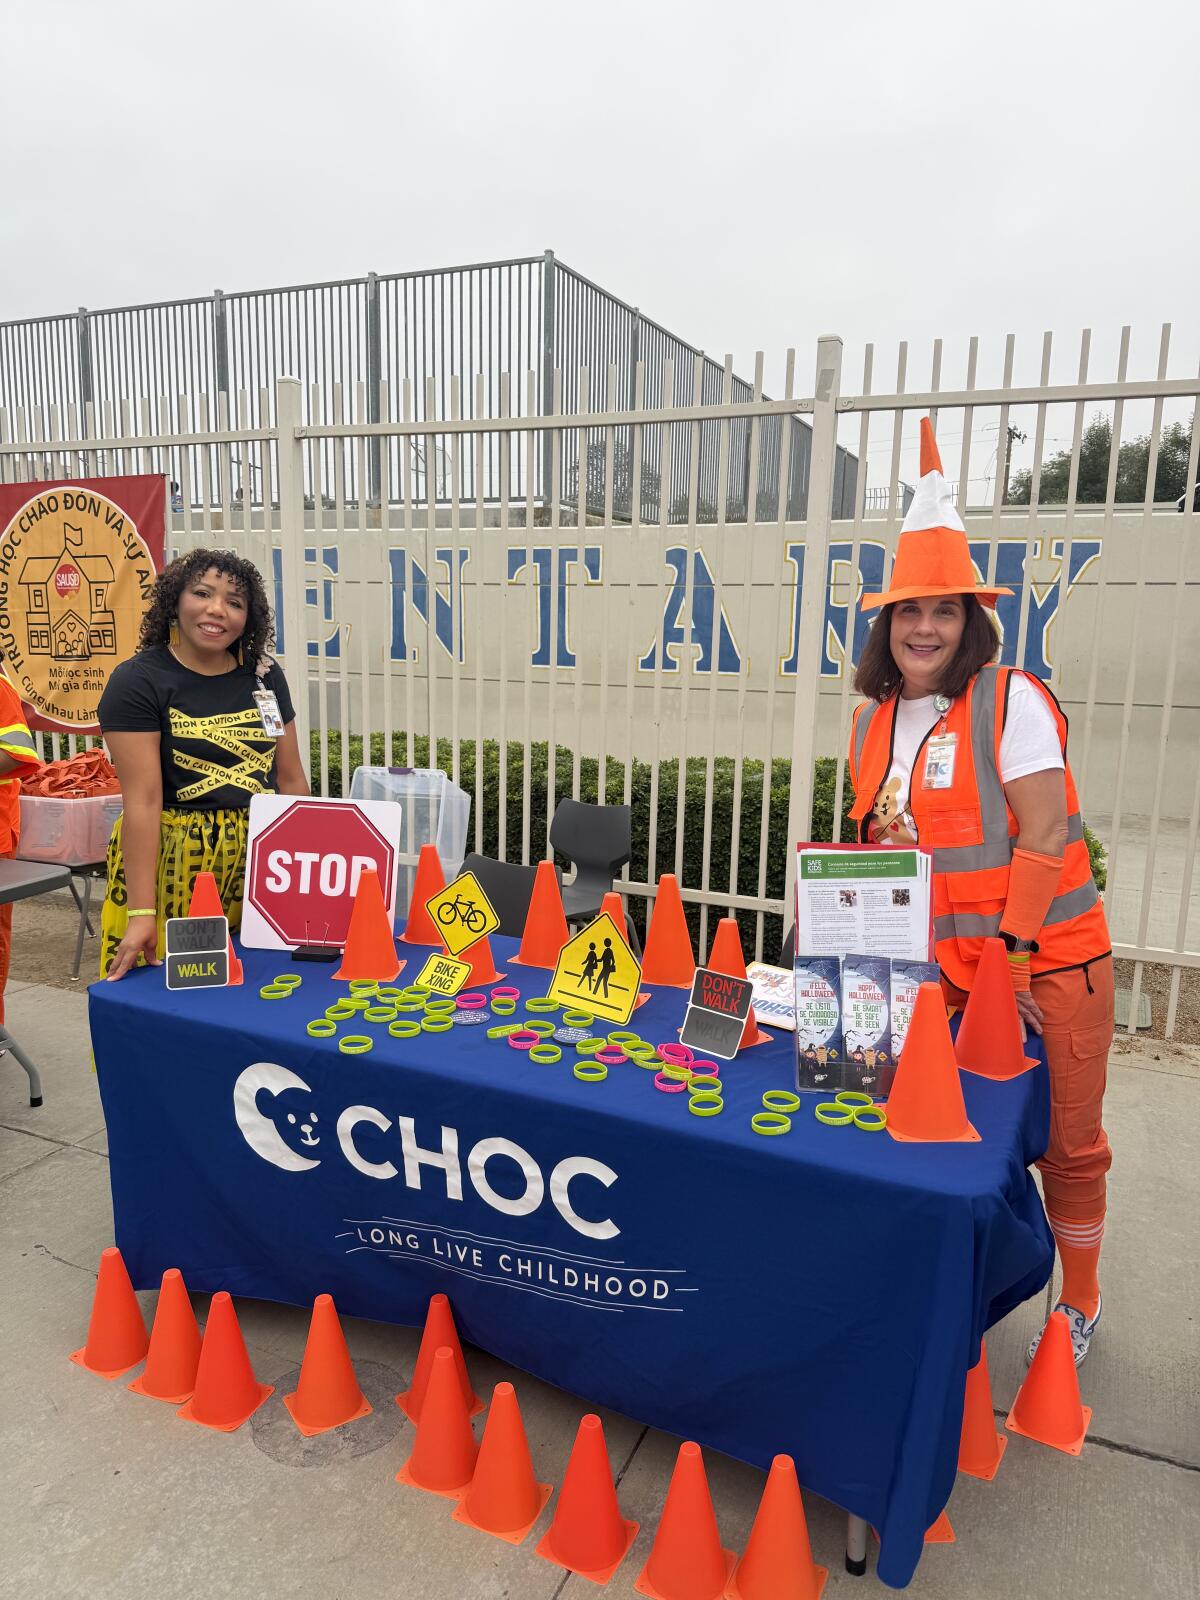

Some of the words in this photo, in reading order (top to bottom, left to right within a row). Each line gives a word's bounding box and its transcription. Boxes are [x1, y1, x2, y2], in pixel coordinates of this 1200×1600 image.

[19, 496, 58, 533] CHÀO
[84, 667, 104, 678] sinh
[62, 681, 80, 692] gia
[82, 680, 103, 691] đình
[200, 715, 242, 727] CAUTION
[202, 729, 241, 753] CAUTION
[192, 762, 232, 780] CAUTION
[265, 849, 378, 897] STOP
[177, 936, 216, 951] WALK
[177, 962, 217, 978] WALK
[434, 961, 461, 979] BIKE
[425, 974, 454, 991] XING
[702, 975, 746, 1001] DON'T
[703, 990, 741, 1014] WALK
[336, 1104, 621, 1240] CHOC
[357, 1226, 420, 1250] LONG
[432, 1237, 483, 1267] LIVE
[499, 1253, 669, 1300] CHILDHOOD
